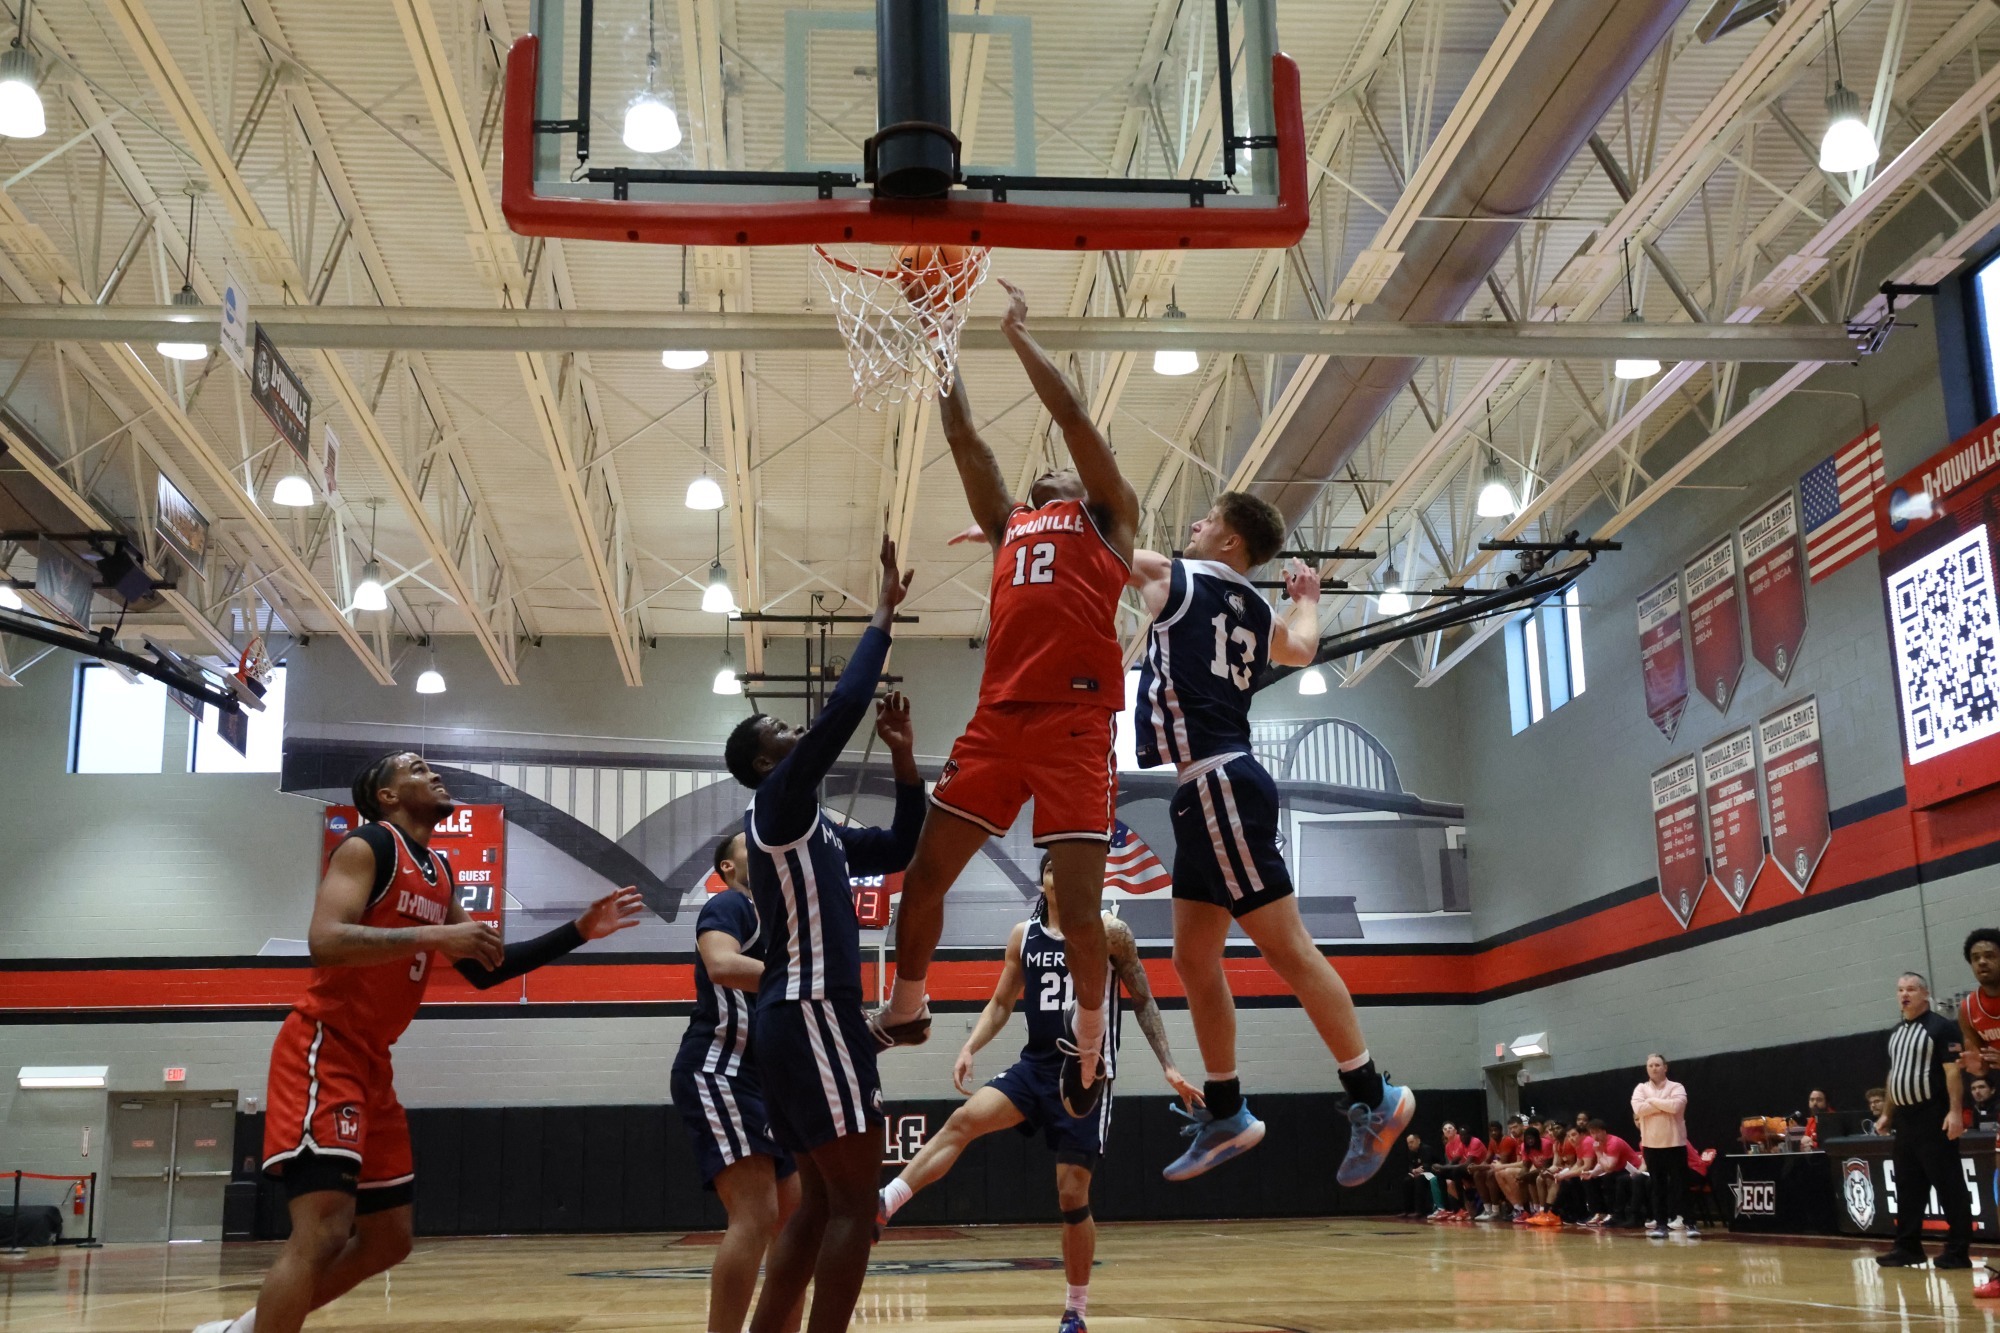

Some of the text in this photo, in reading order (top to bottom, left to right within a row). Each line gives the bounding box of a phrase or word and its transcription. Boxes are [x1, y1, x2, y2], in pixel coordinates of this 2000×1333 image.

[1772, 502, 1792, 526] SAINTS
[1712, 544, 1730, 566] SAINTS
[1748, 542, 1761, 558] MEN'S
[1012, 542, 1056, 586] 12
[1210, 612, 1257, 691] 13
[1793, 706, 1815, 727] SAINTS
[1732, 736, 1751, 756] SAINTS
[1768, 728, 1812, 755] MEN'S VOLLEYBALL
[1676, 763, 1694, 782] SAINTS
[1710, 757, 1748, 781] MEN'S VOLLEYBALL
[329, 821, 348, 830] NCAA
[458, 870, 492, 882] GUEST
[460, 886, 493, 911] 21
[856, 891, 878, 919] 13
[1040, 972, 1074, 1012] 21
[168, 1069, 184, 1080] EXIT
[1742, 1184, 1775, 1212] ECC
